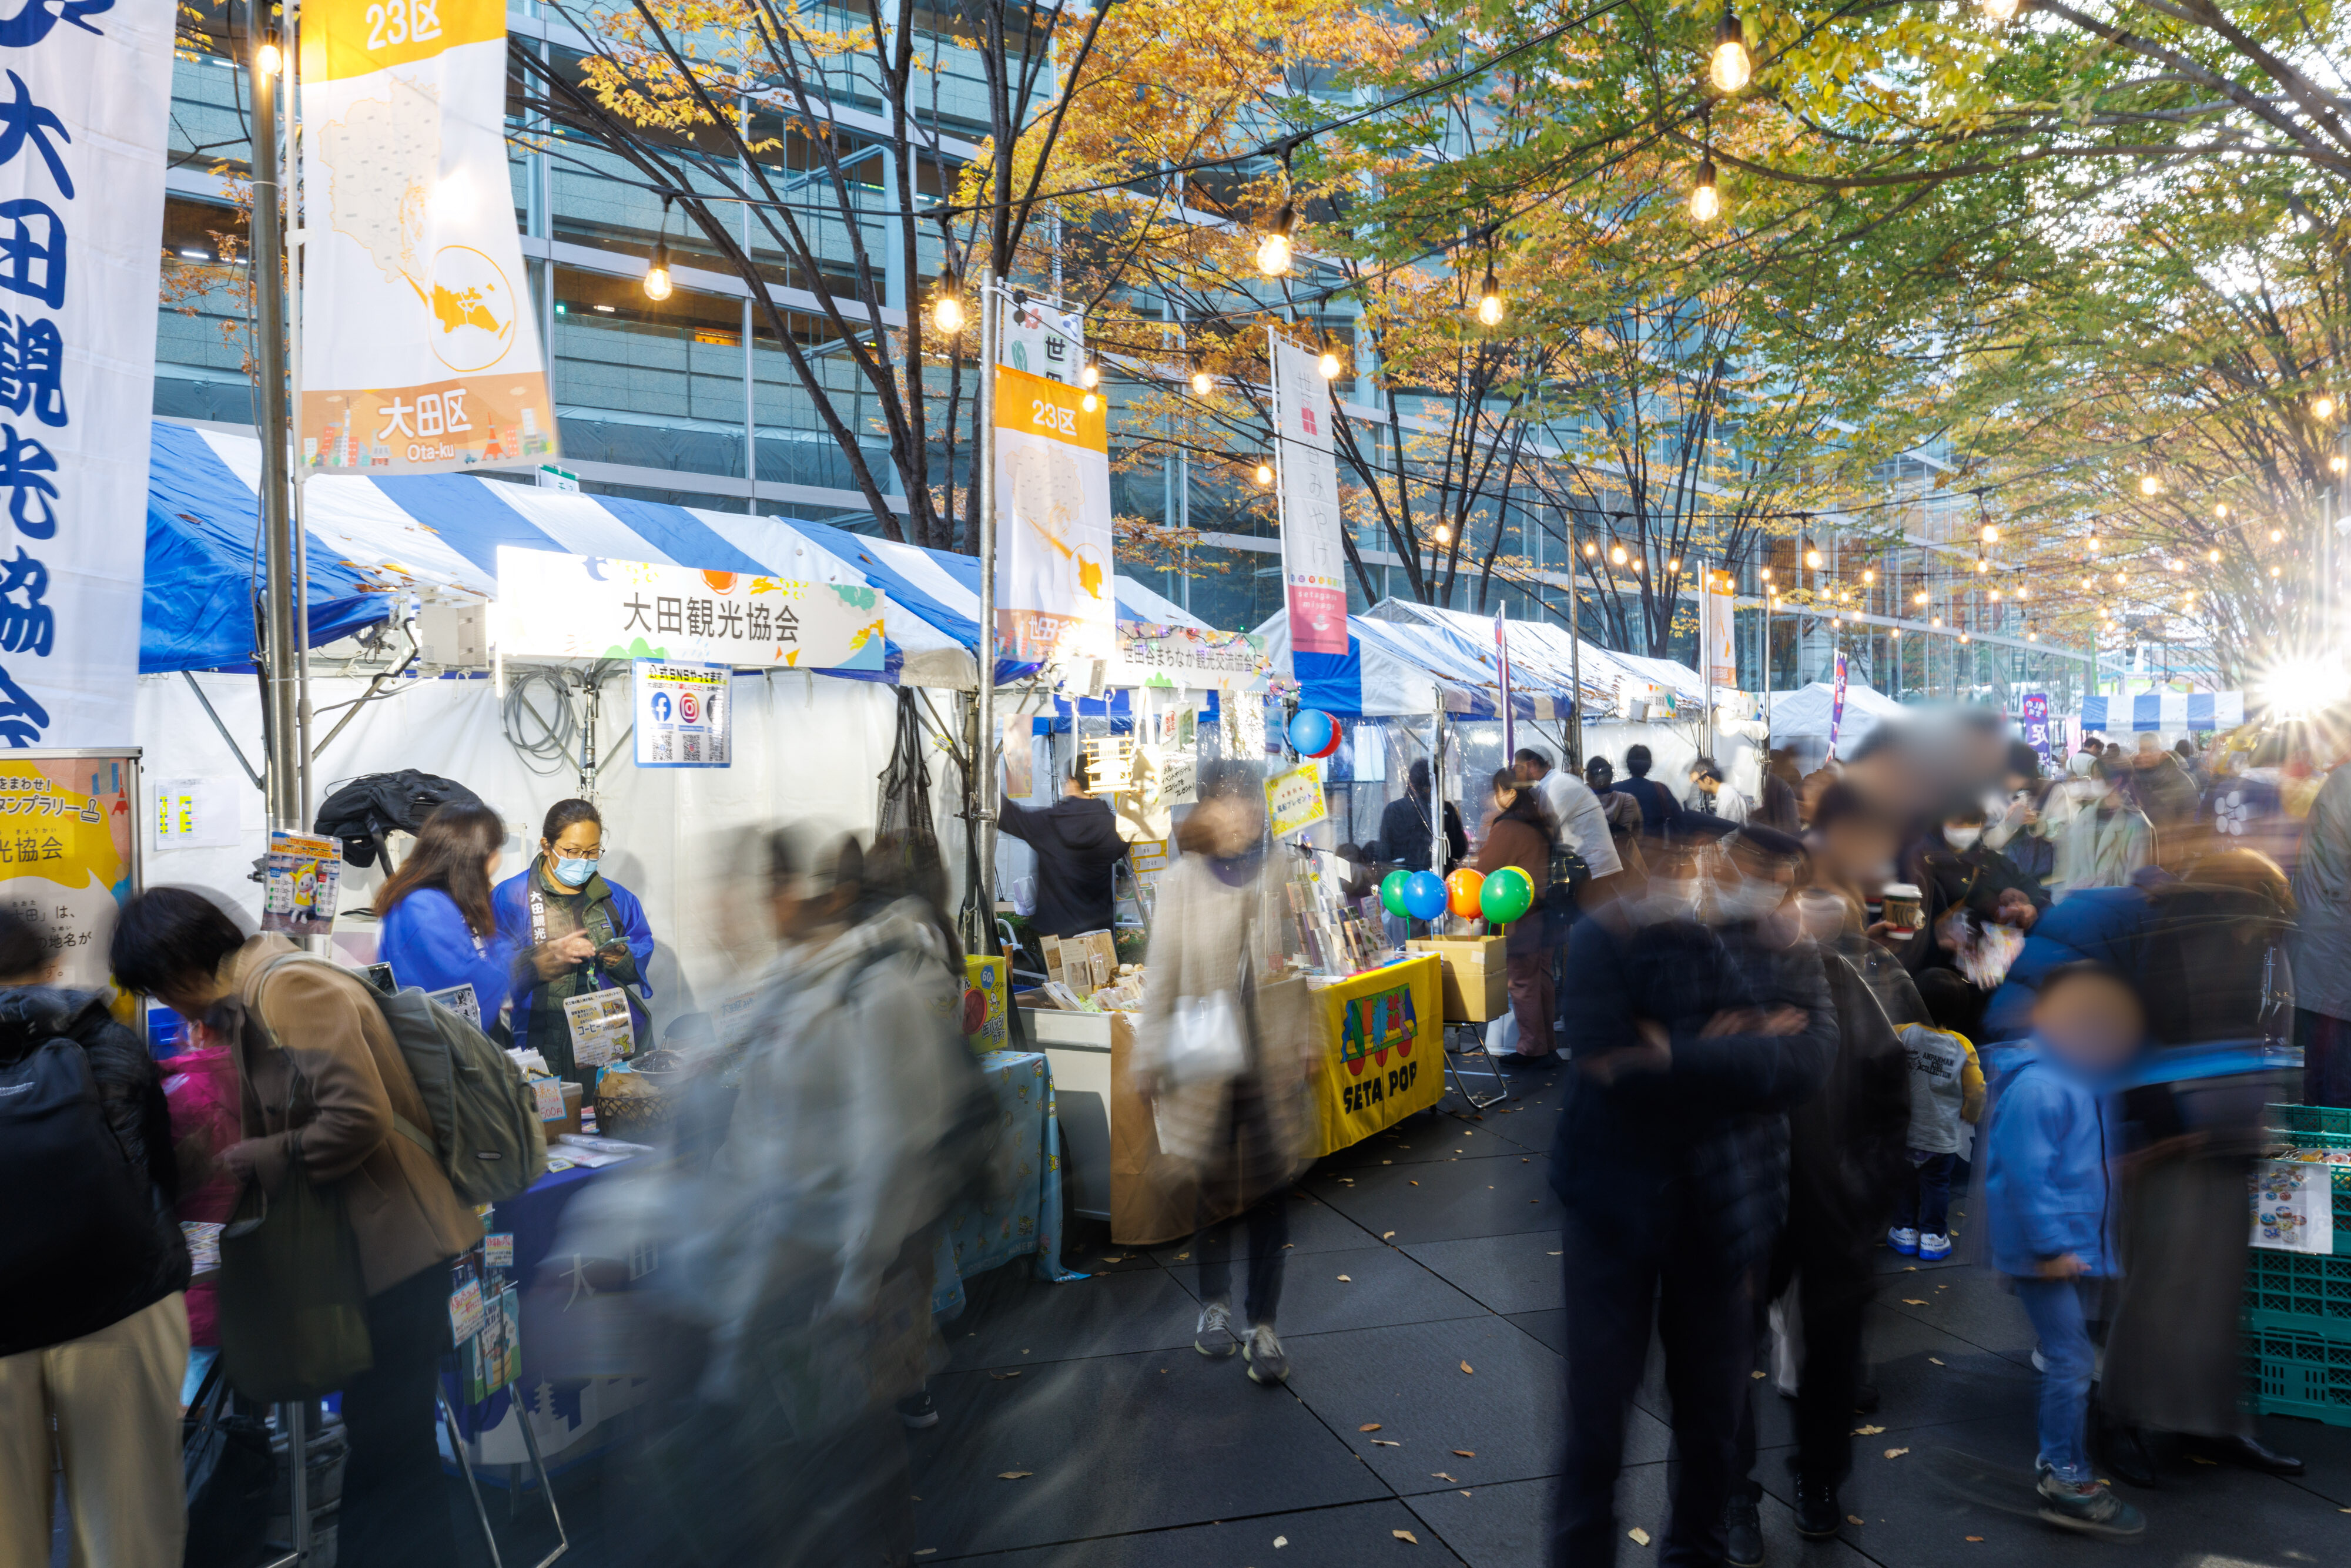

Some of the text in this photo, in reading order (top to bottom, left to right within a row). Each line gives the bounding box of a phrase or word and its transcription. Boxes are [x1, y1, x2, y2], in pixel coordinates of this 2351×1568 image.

[366, 0, 442, 50] 23区
[379, 388, 473, 440] 大田区
[1033, 400, 1077, 436] 23区
[407, 442, 454, 461] Ota-ku
[622, 592, 800, 644] 大田観光協会
[530, 890, 546, 945] 大田観光
[578, 1024, 601, 1036] コーヒー
[1344, 1061, 1416, 1114] SETA POP
[1931, 1061, 1943, 1070] KIDS
